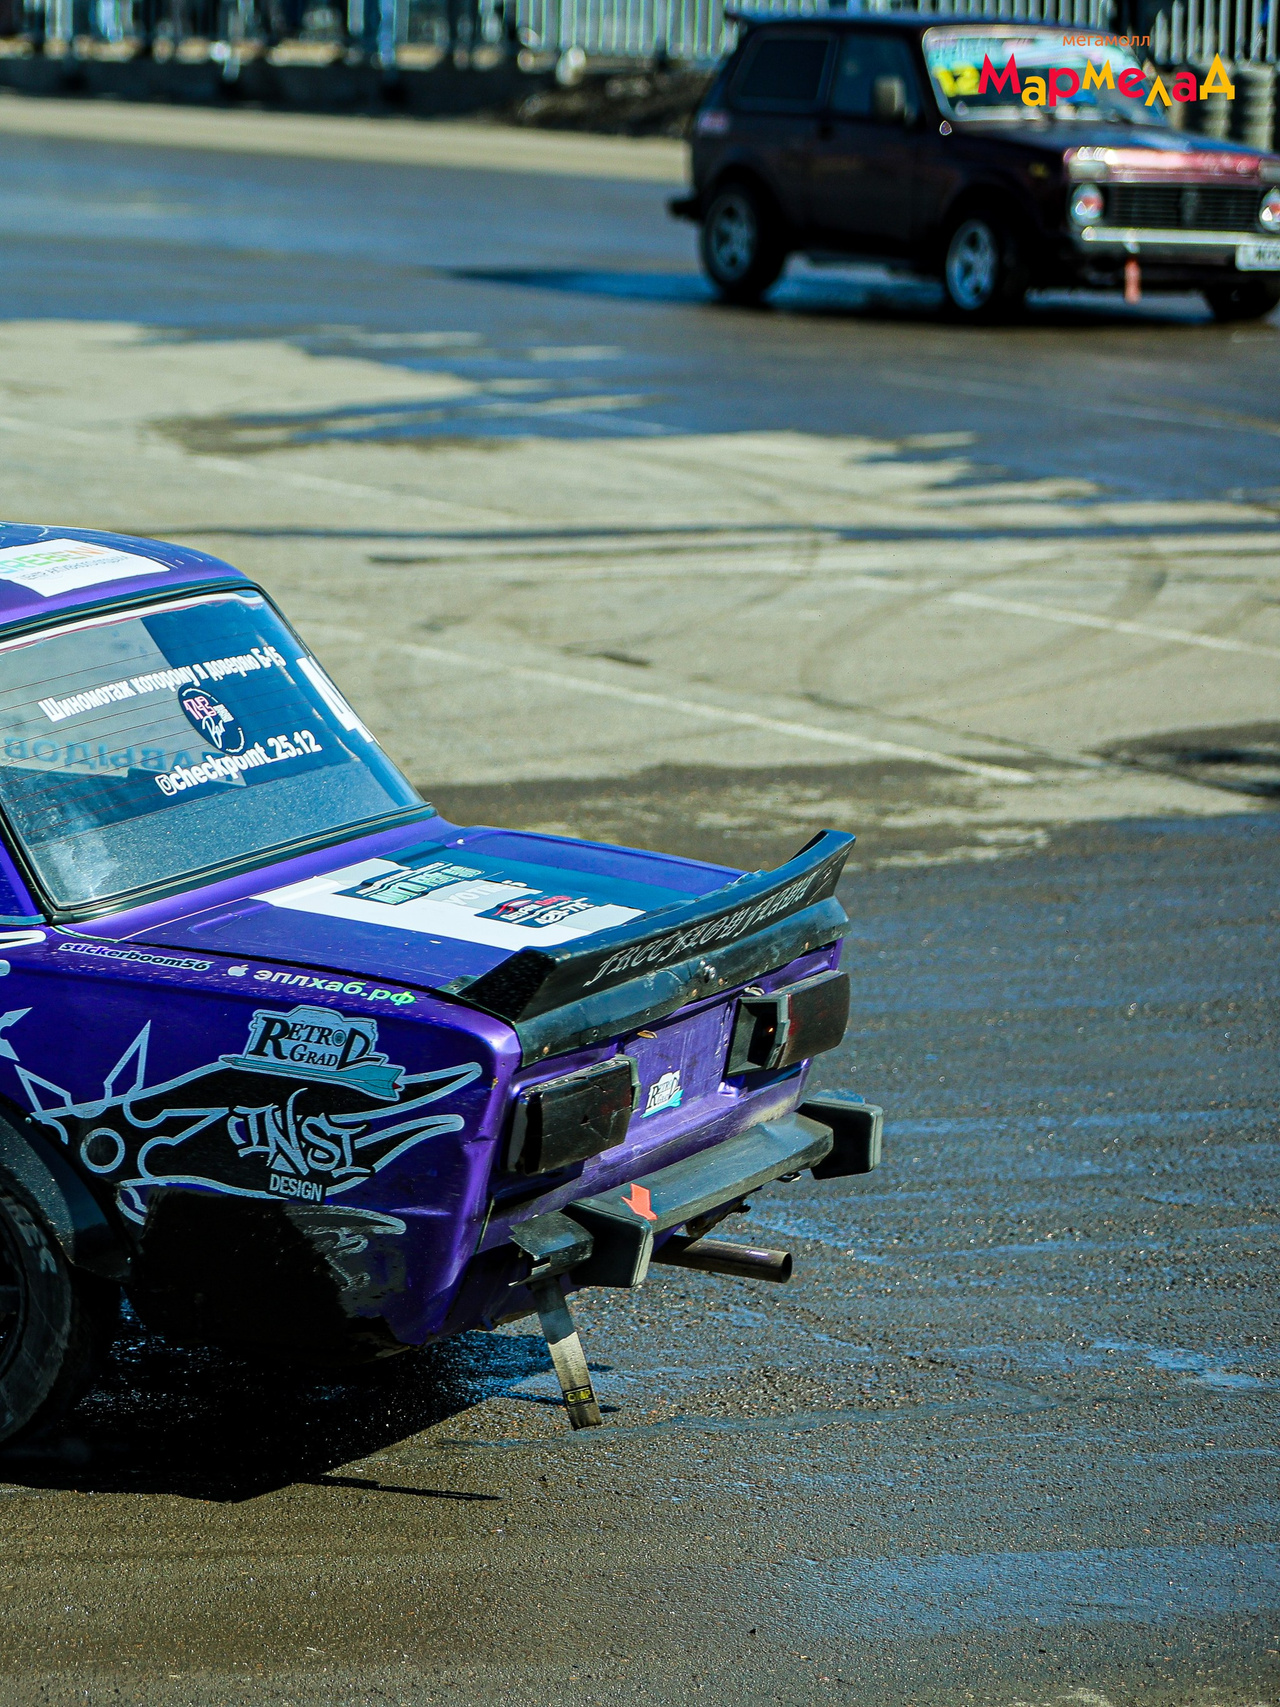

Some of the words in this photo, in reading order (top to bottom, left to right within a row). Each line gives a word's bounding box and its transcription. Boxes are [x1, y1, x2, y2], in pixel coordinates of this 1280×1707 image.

[59, 942, 215, 972] stickerboom56
[253, 968, 417, 1007] эплхаб.рф
[270, 1173, 323, 1202] DESIGN
